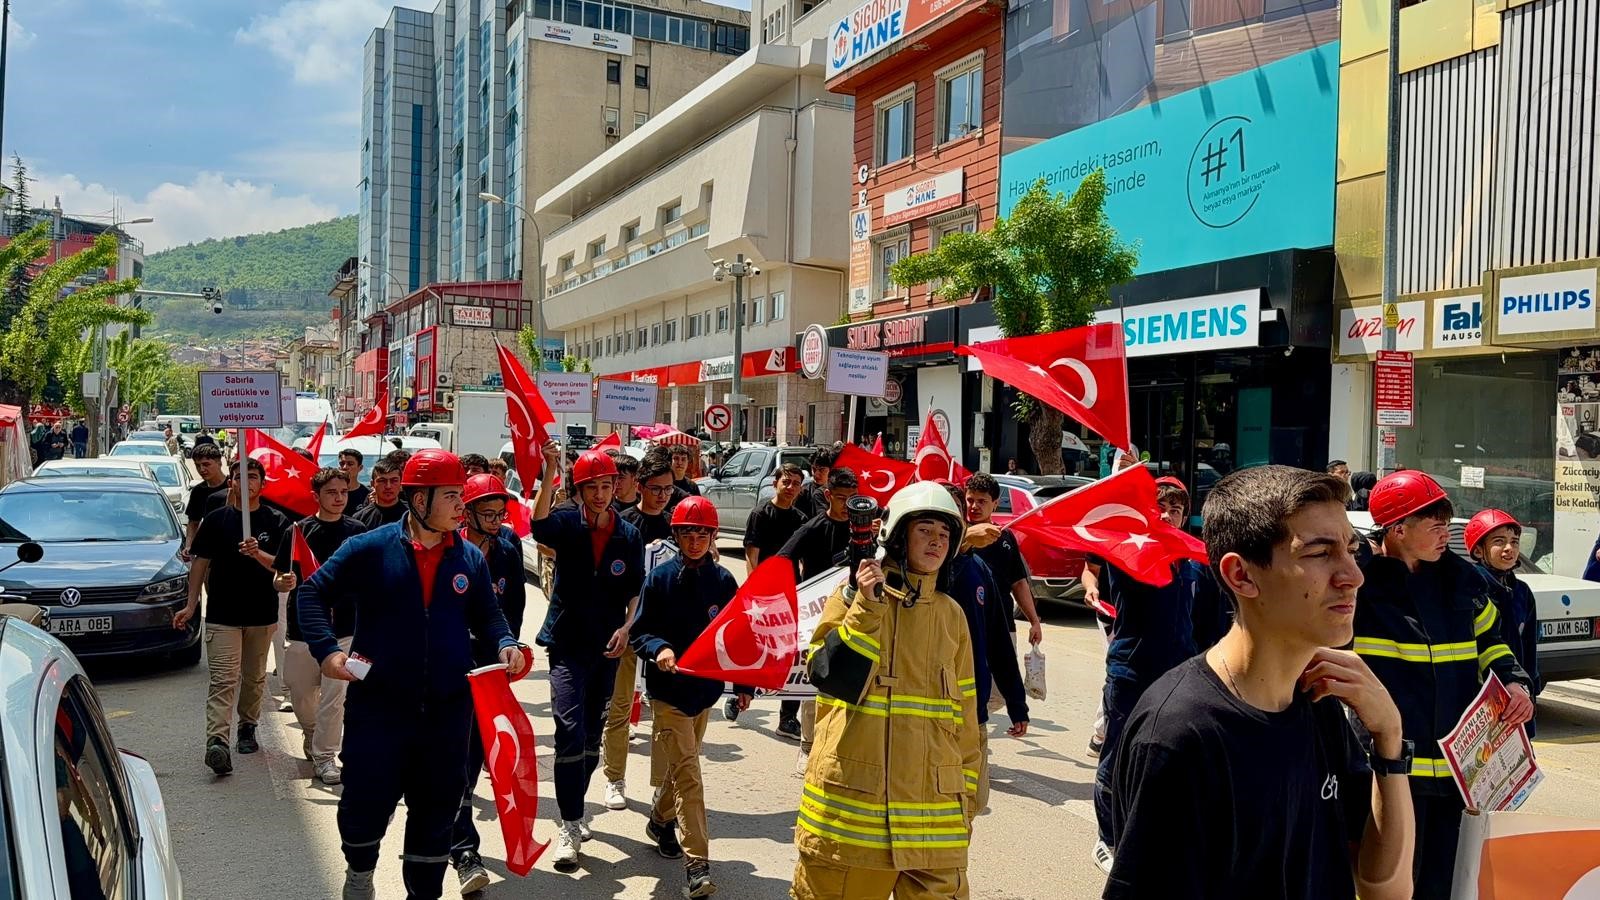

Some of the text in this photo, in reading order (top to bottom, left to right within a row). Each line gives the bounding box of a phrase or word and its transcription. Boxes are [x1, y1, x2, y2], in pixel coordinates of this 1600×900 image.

[852, 10, 902, 60] HANE
[1102, 140, 1162, 170] tasarım,
[1201, 127, 1245, 187] #1
[915, 189, 936, 205] HANE
[1504, 289, 1590, 315] PHILIPS
[454, 309, 491, 320] SATILIK
[1124, 304, 1247, 346] SIEMENS
[1348, 316, 1416, 339] arzm
[847, 317, 924, 350] SUCUK SARAYI
[225, 375, 254, 384] Sabırla
[544, 379, 568, 388] Öğrenen
[211, 388, 257, 397] dürüstlükle
[560, 389, 580, 397] gelişen
[613, 383, 634, 391] Hayatın
[224, 401, 258, 409] ustalıkla
[219, 412, 264, 422] yetişiyoruz
[1555, 482, 1583, 492] Tekstil
[1556, 495, 1570, 507] Üst
[59, 620, 80, 631] ARA
[88, 618, 111, 630] 085
[1543, 621, 1589, 636] 10 AKM 648
